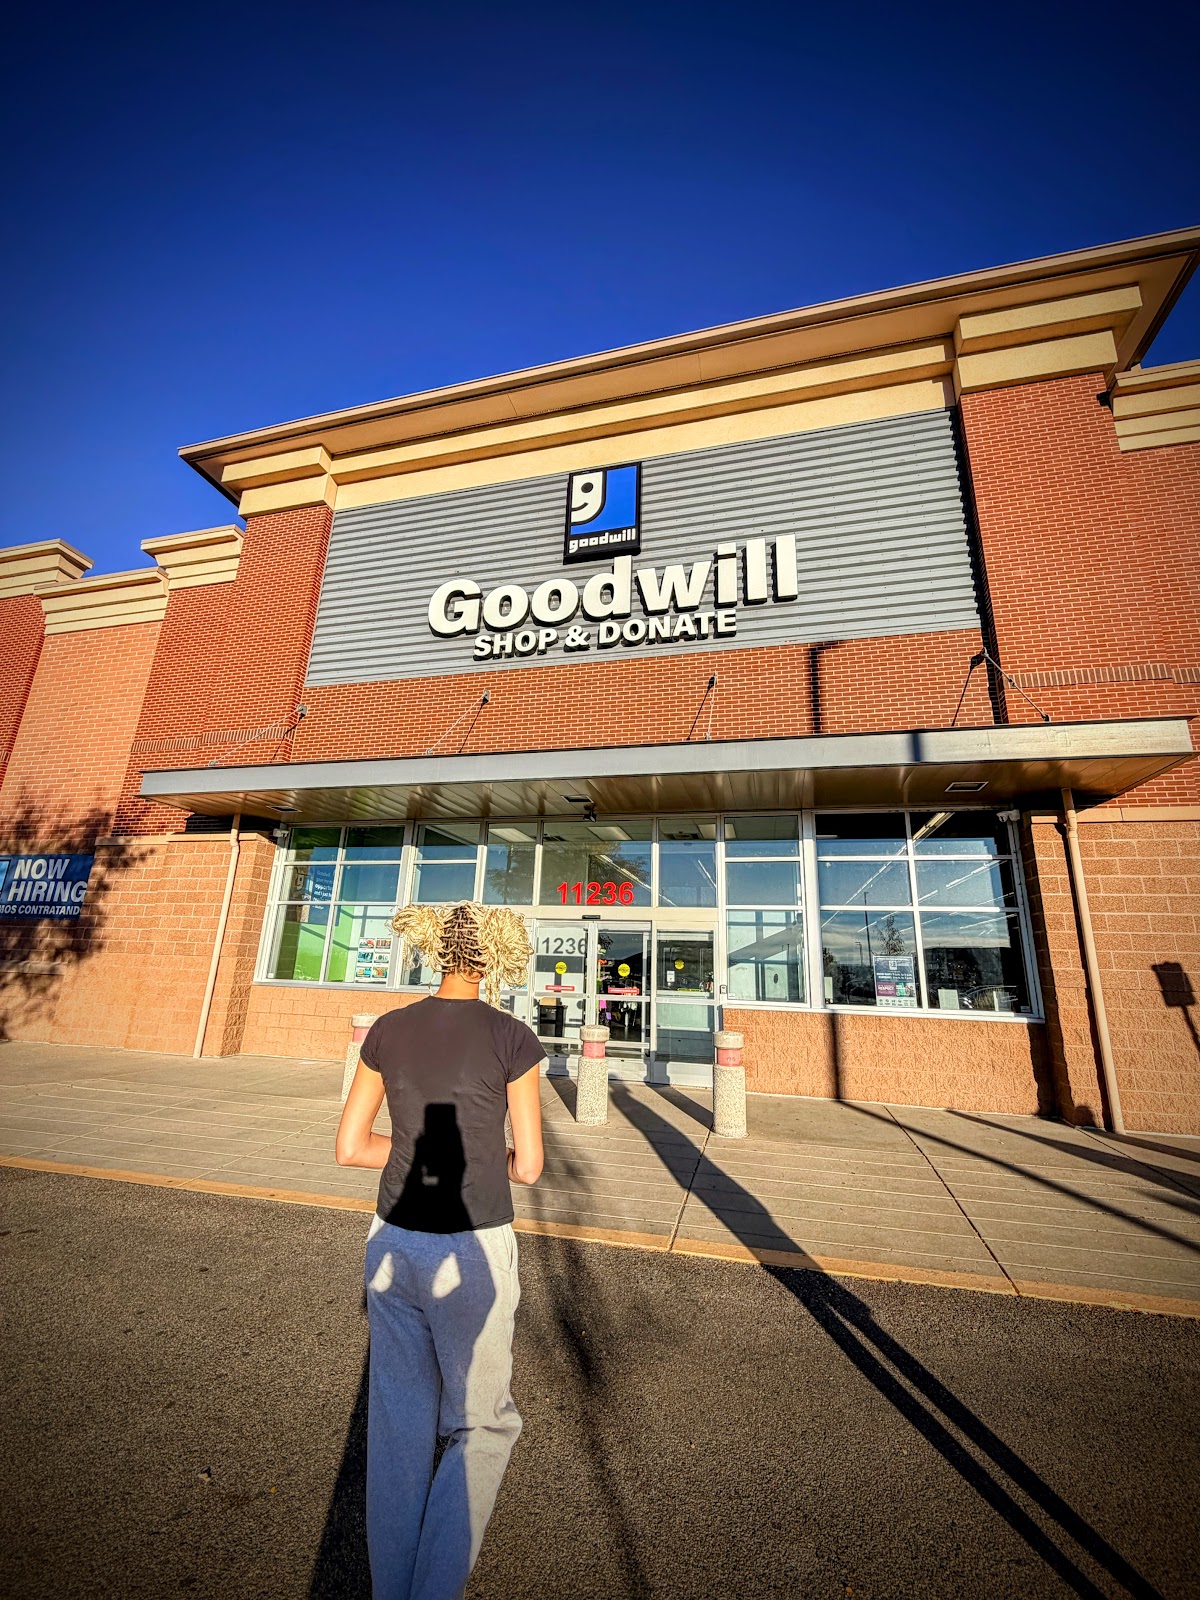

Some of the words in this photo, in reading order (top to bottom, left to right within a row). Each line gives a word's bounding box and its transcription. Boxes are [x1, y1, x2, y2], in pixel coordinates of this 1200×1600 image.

[568, 528, 636, 554] goodwill
[428, 533, 798, 636] Goodwill
[474, 627, 558, 658] SHOP
[565, 624, 591, 649] &
[598, 608, 738, 646] DONATE
[13, 858, 70, 880] NOW
[7, 880, 88, 903] HIRING
[556, 881, 635, 906] 11236
[18, 905, 82, 916] CONTRATAND
